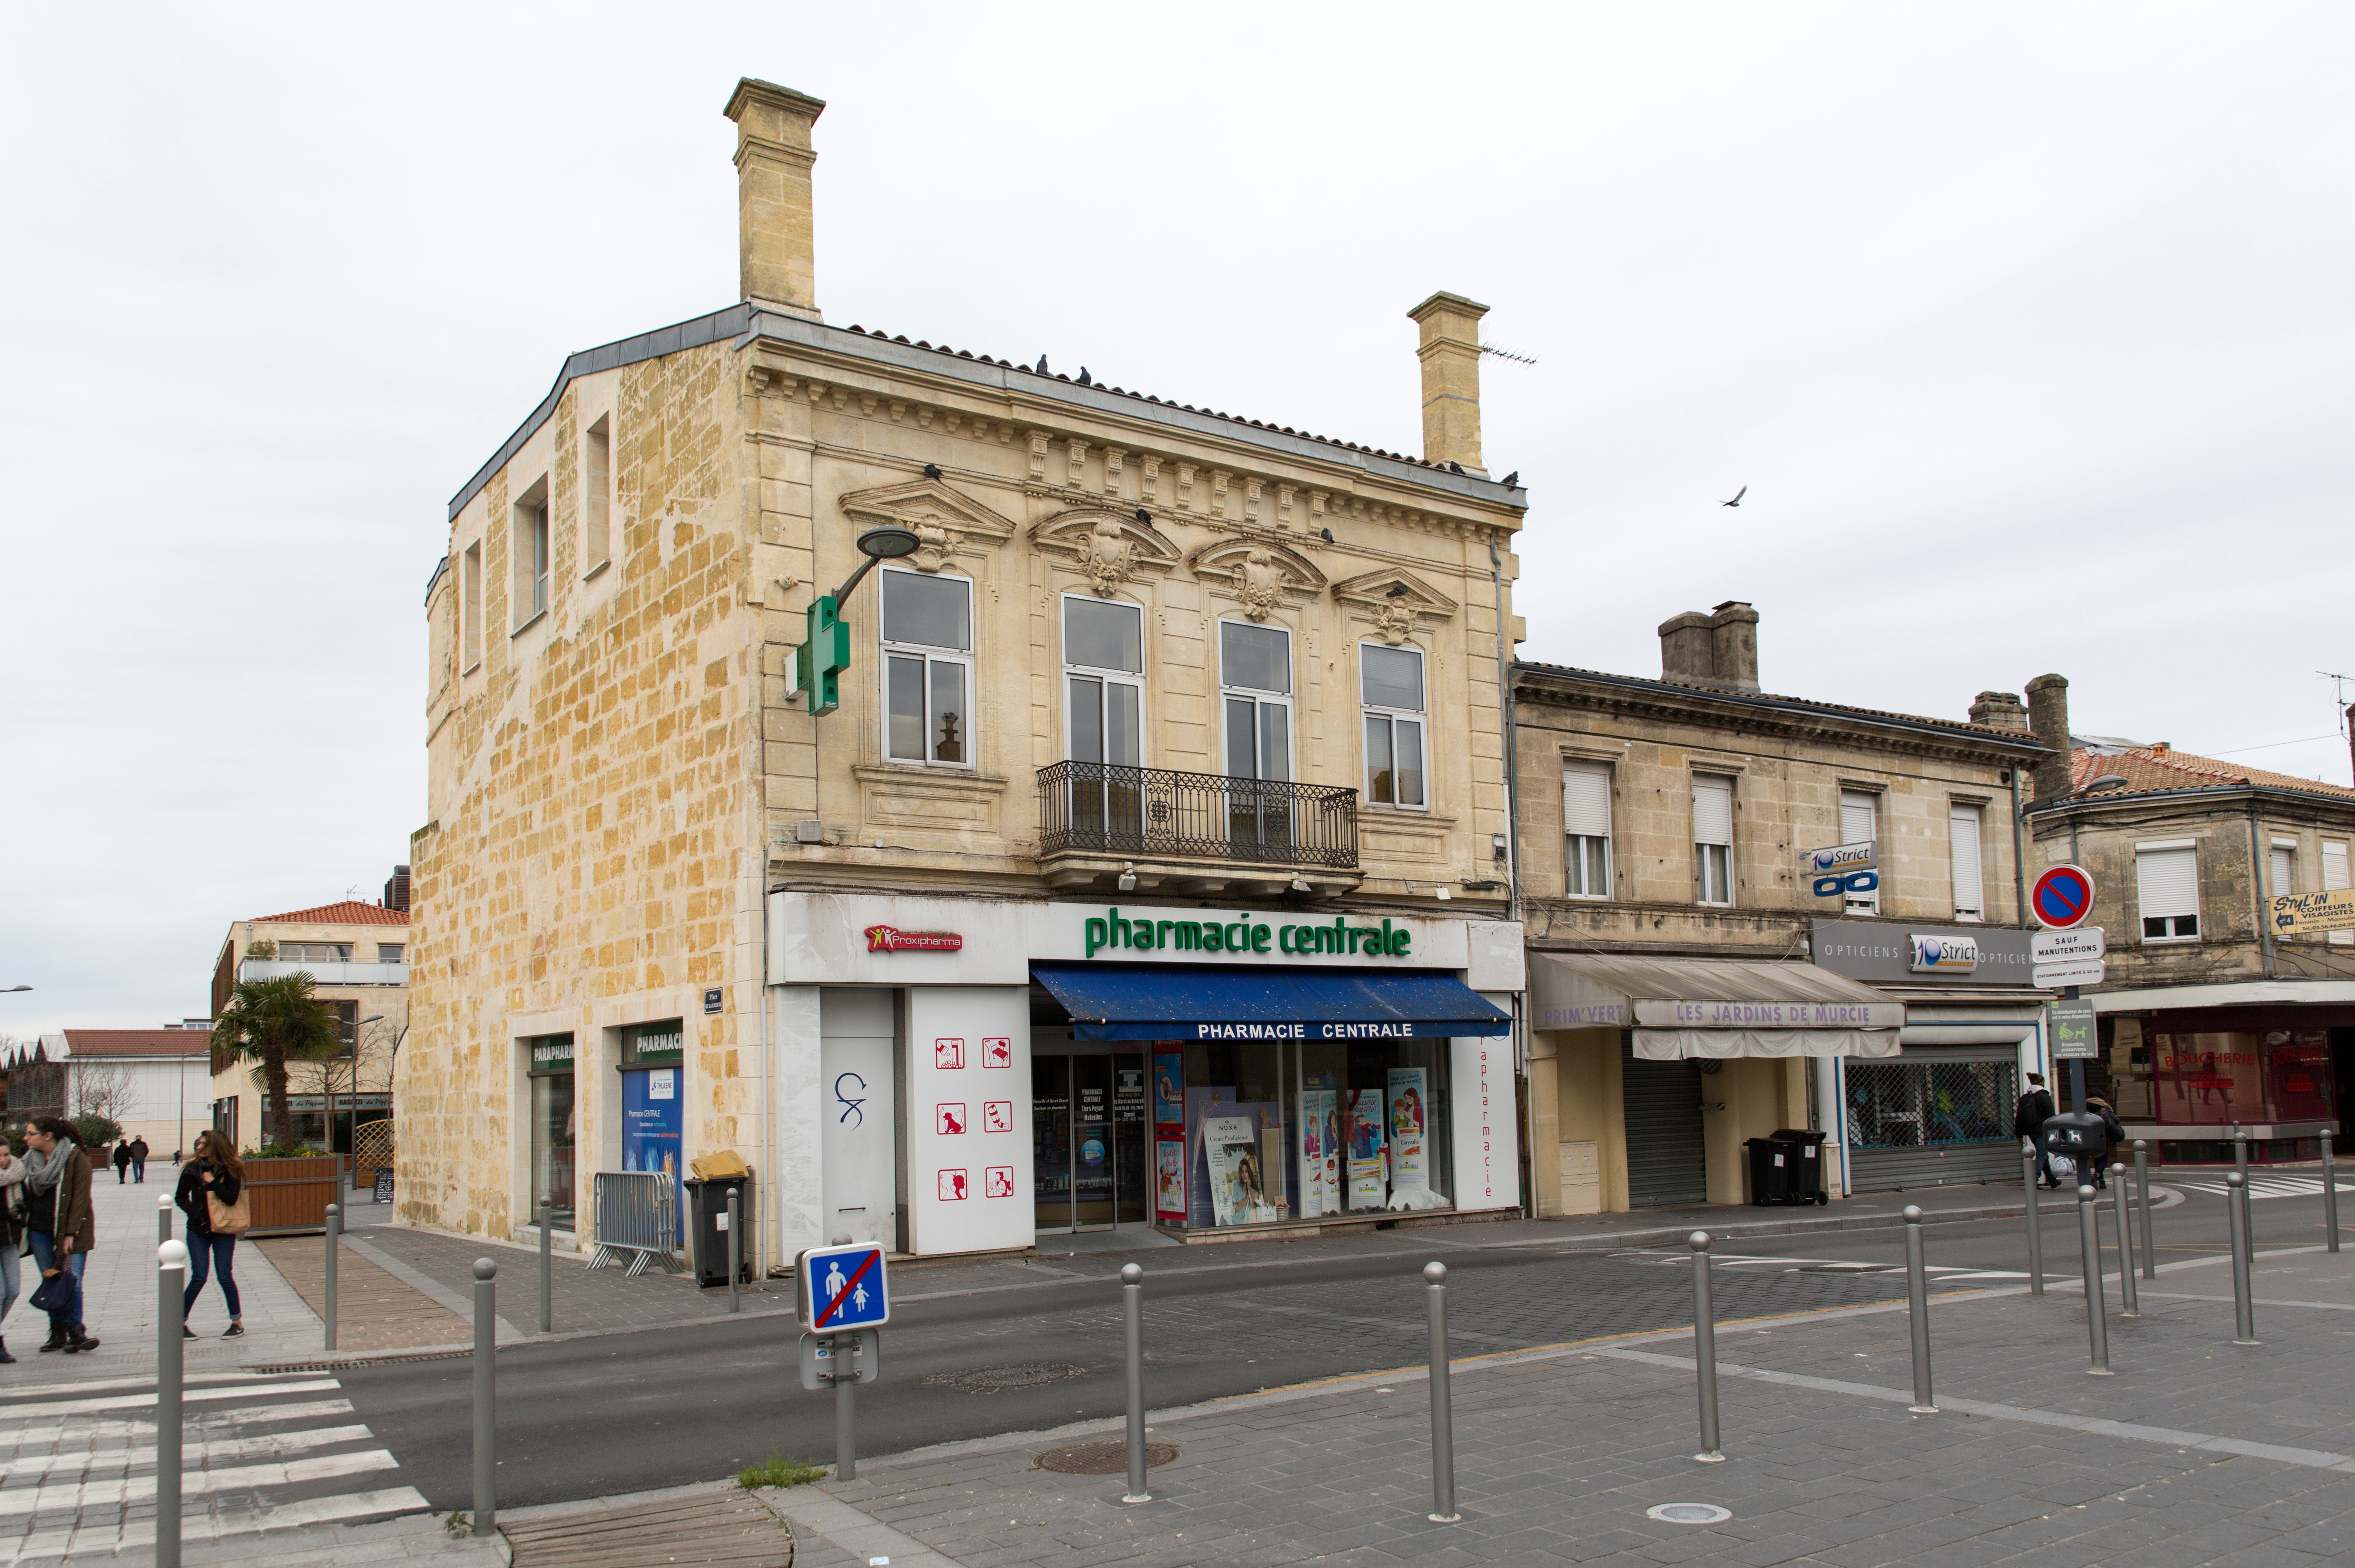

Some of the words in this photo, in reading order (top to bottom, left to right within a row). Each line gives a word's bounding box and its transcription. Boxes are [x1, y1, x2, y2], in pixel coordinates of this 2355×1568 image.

[2301, 903, 2353, 913] COIFFEURS
[2302, 909, 2354, 919] VISAGISTES
[1085, 907, 1272, 958] pharmacie
[1279, 916, 1411, 955] centrale
[893, 935, 960, 947] Proxipharma
[1825, 945, 1898, 958] OPTICIENS
[2038, 945, 2097, 956] MANUTENTIONS
[1544, 1005, 1623, 1024] PRIM'VERT
[1677, 1005, 1703, 1021] LES
[1712, 1005, 1781, 1021] JARDINS
[1790, 1007, 1807, 1021] DE
[1815, 1007, 1870, 1022] MURCIE
[1199, 1024, 1305, 1038] PHARMACIE
[1322, 1023, 1413, 1037] CENTRALE
[2165, 1052, 2256, 1067] BOUCHERIE
